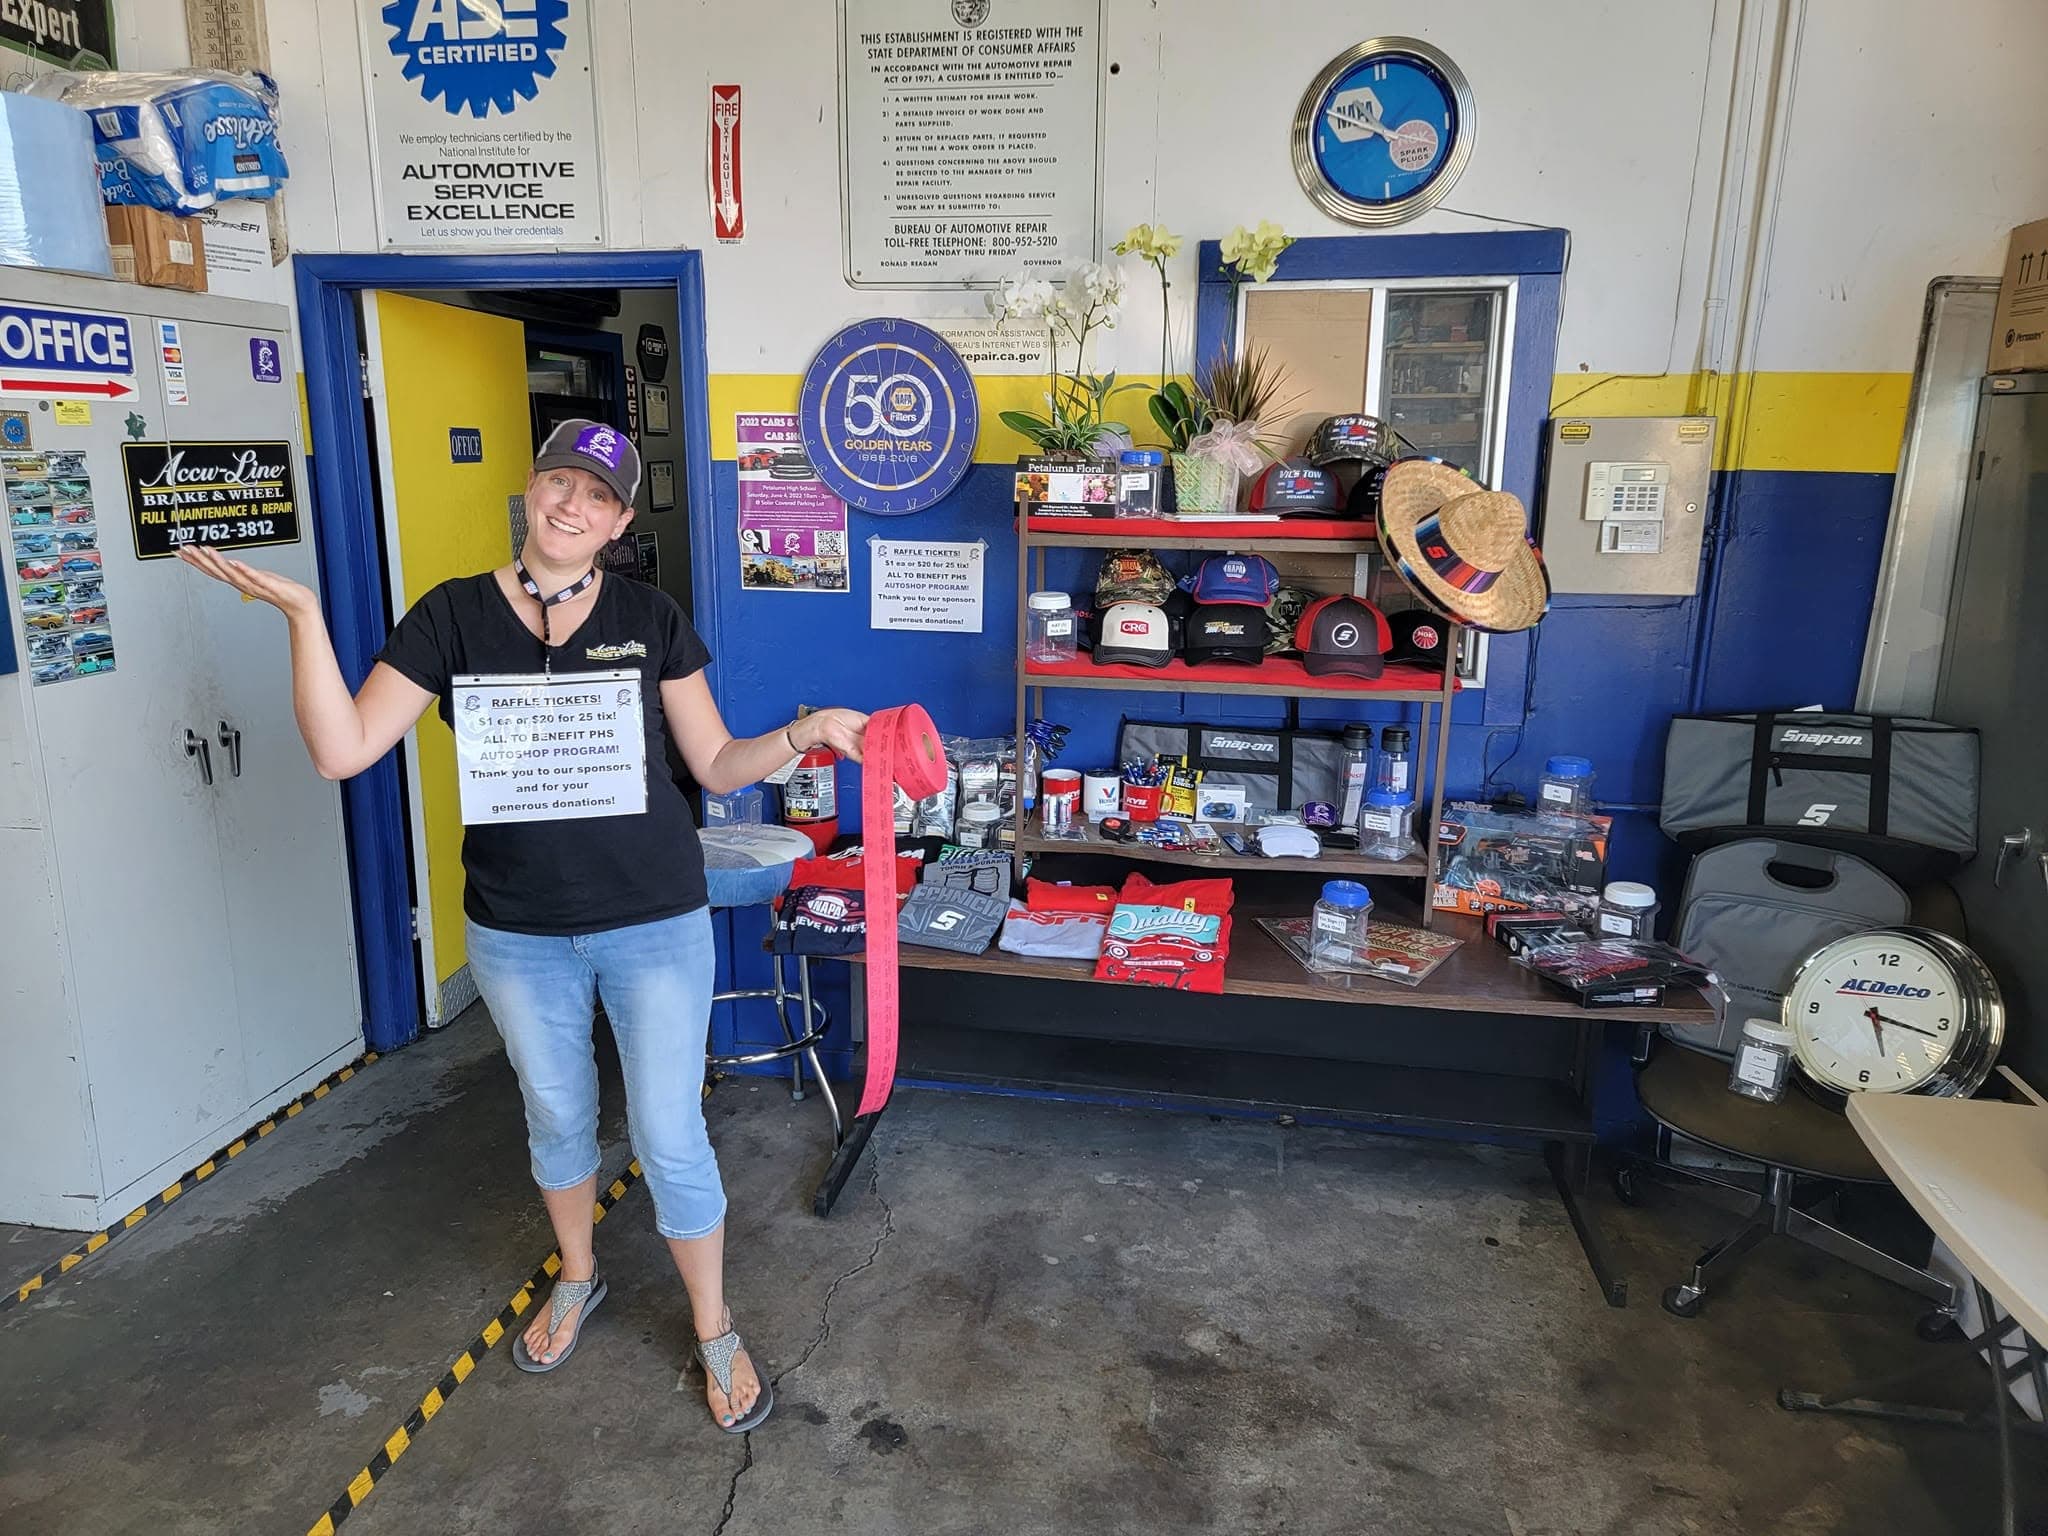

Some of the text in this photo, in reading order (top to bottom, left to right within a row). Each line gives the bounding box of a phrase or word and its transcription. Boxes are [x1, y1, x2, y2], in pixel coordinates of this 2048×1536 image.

[1, 0, 81, 49] Expert
[407, 0, 539, 42] ASE
[860, 26, 1083, 44] THIS ESTABLISHMENT IS REGISTERED WITH THE
[418, 43, 538, 65] CERTIFIED
[868, 42, 1076, 59] STATE DEPARTMENT OF CONSUMER AFFAIRS
[871, 59, 1072, 73] IN ACCORDANCE WITH THE AUTOMOTIVE REPAIR
[901, 75, 912, 83] OF
[946, 73, 990, 82] CUSTOMER
[1005, 72, 1042, 80] ENTITLED
[716, 103, 738, 117] FIRE
[400, 131, 572, 145] We employ technicians certified by the
[439, 145, 531, 158] National Institute for
[1400, 146, 1428, 157] SPARK
[1400, 153, 1429, 164] PLUGS
[402, 162, 575, 180] AUTOMOTIVE
[434, 183, 544, 200] SERVICE
[407, 203, 575, 221] EXCELLENCE
[240, 222, 261, 234] EFI
[421, 225, 564, 238] Let us show you their credentials
[894, 222, 1048, 234] BUREAU OF AUTOMOTIVE REPAIR
[884, 236, 1058, 248] TOLL-FREE TELEPHONE: 800-952-5210
[924, 249, 961, 257] MONDAY
[988, 248, 1017, 256] FRIDAY
[1, 314, 129, 366] OFFICE
[987, 330, 998, 338] OR
[982, 341, 1021, 349] INTERNET
[1022, 341, 1041, 349] WEB
[168, 370, 183, 378] VISA
[624, 367, 640, 445] CHEVY
[845, 373, 933, 437] 50
[740, 417, 795, 427] 2022 CARS &
[1357, 418, 1378, 428] TOW
[764, 432, 784, 441] CAR
[451, 435, 481, 456] OFFICE
[844, 439, 933, 452] GOLDEN YEARS
[577, 446, 615, 468] AUTOSHOP
[139, 450, 286, 487] Accu-Line
[1027, 463, 1105, 473] Petaluma Floral
[1303, 469, 1322, 478] TOW
[143, 487, 285, 507] BRAKE & WHEEL
[140, 501, 293, 525] FULL MAINTENANCE & REPAIR
[167, 520, 275, 544] 707 762-3812
[893, 548, 961, 557] RAFFLE TICKETS!
[916, 572, 949, 580] BENEFIT
[884, 582, 969, 591] AUTOSHOP PROGRAM!
[1418, 630, 1434, 639] NGK
[491, 694, 601, 709] RAFFLE TICKETS!
[479, 717, 493, 726] $1
[516, 717, 529, 725] or
[532, 714, 554, 724] $20
[558, 713, 575, 723] for
[578, 712, 593, 722] 25
[597, 711, 617, 721] tix!
[511, 733, 528, 743] TO
[532, 731, 585, 742] BENEFIT
[589, 729, 614, 739] PHS
[1781, 729, 1863, 747] Snap-on
[1209, 736, 1274, 752] Snap-on
[480, 745, 620, 761] AUTOSHOP PROGRAM!
[469, 762, 632, 780] Thank you to our sponsors
[516, 781, 589, 793] and for your
[491, 796, 616, 814] generous donations!
[812, 900, 843, 917] NAPA
[912, 886, 1005, 918] ECHNICIA
[823, 925, 839, 934] IN
[1108, 910, 1210, 935] Quality
[1367, 932, 1434, 952] GARAGE
[1877, 954, 1901, 967] 12
[1840, 978, 1931, 999] ACDelco
[1808, 1002, 1820, 1014] 9
[1937, 1018, 1949, 1031] 3
[1858, 1070, 1870, 1083] 6
